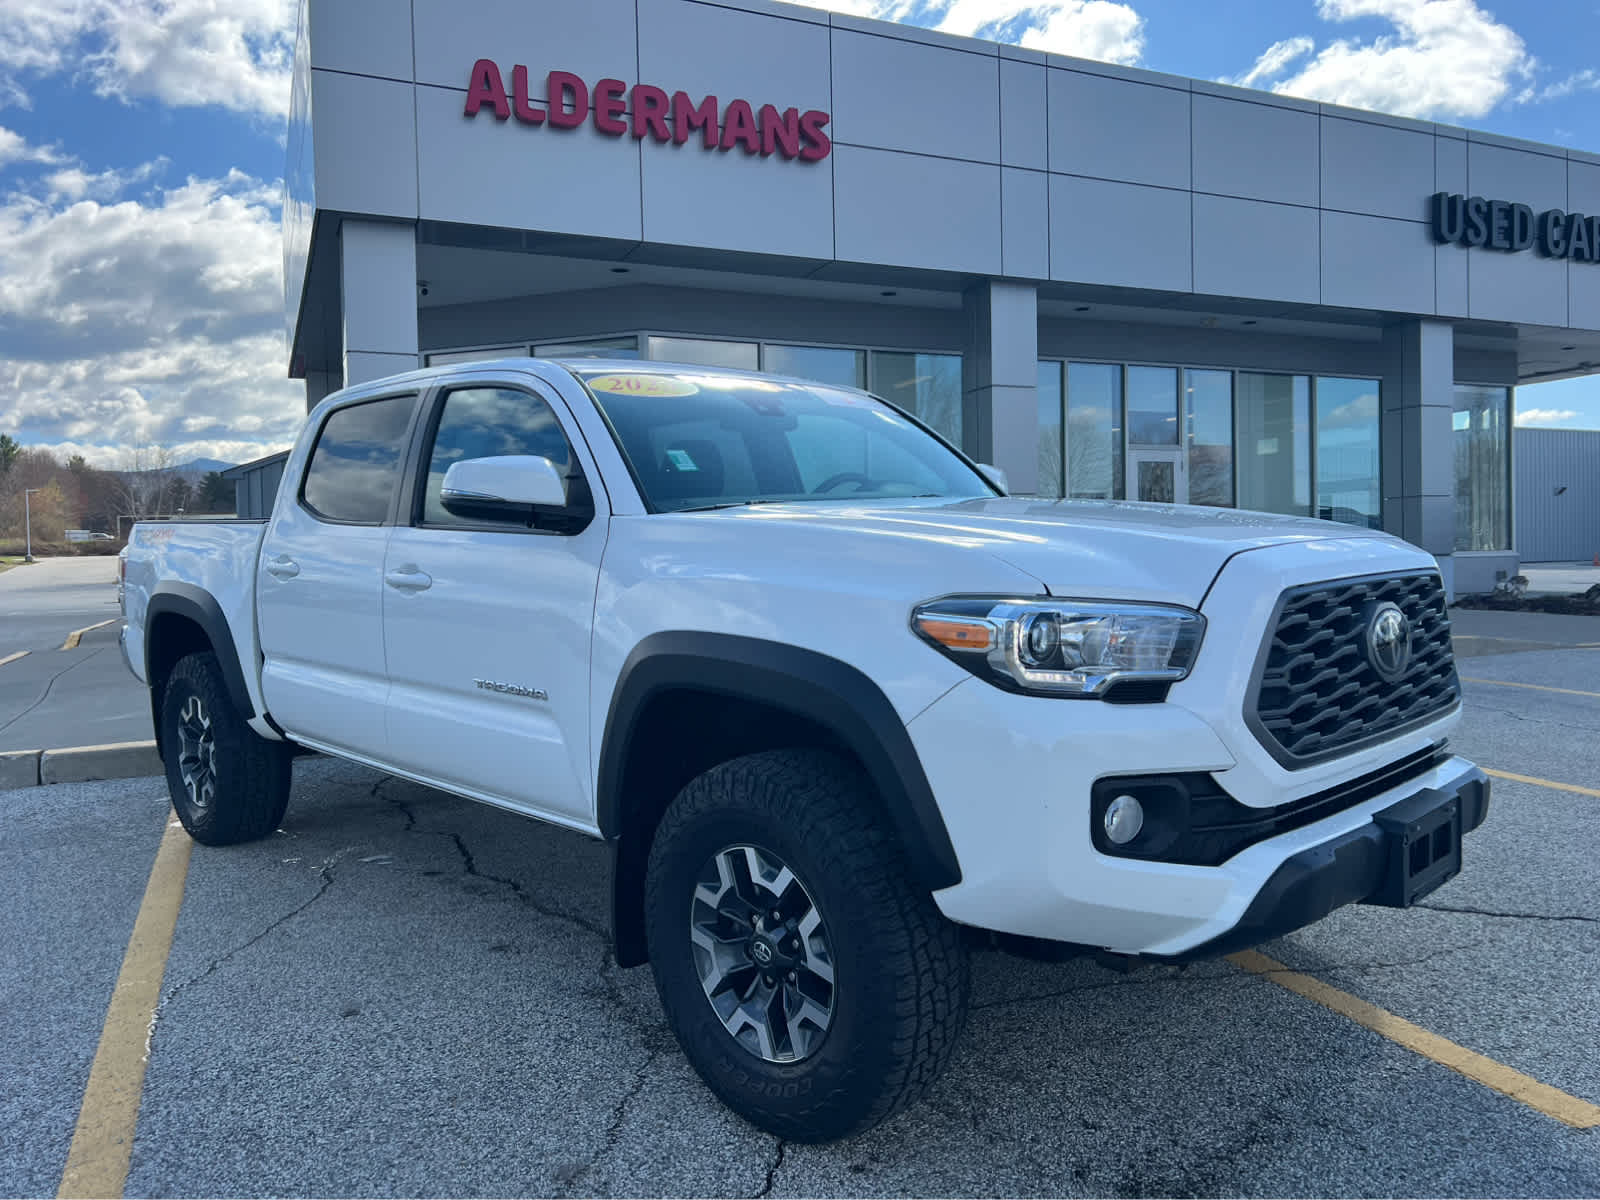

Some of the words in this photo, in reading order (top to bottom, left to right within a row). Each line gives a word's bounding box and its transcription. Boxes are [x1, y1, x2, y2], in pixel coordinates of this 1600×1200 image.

[464, 58, 832, 162] ALDERMANS
[1432, 191, 1535, 252] USED
[472, 678, 549, 701] TACOMA
